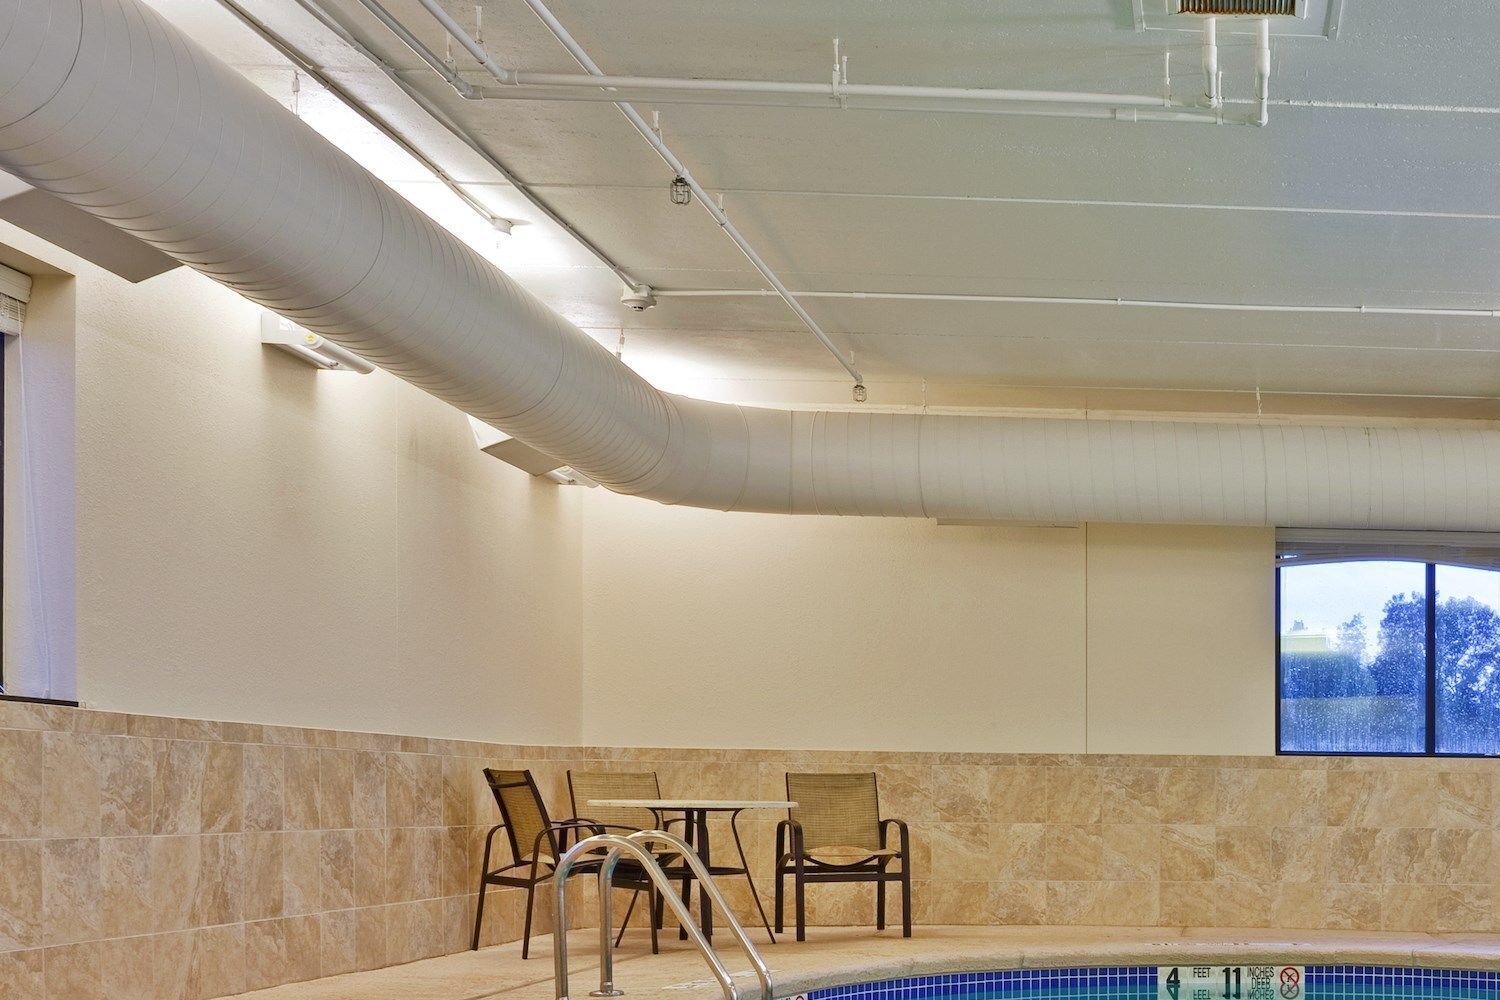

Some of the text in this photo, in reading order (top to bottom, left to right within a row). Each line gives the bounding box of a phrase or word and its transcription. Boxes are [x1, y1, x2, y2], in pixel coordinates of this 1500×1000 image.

[1166, 967, 1180, 985] 4
[1193, 968, 1211, 978] FEET
[1247, 966, 1274, 978] INCHES
